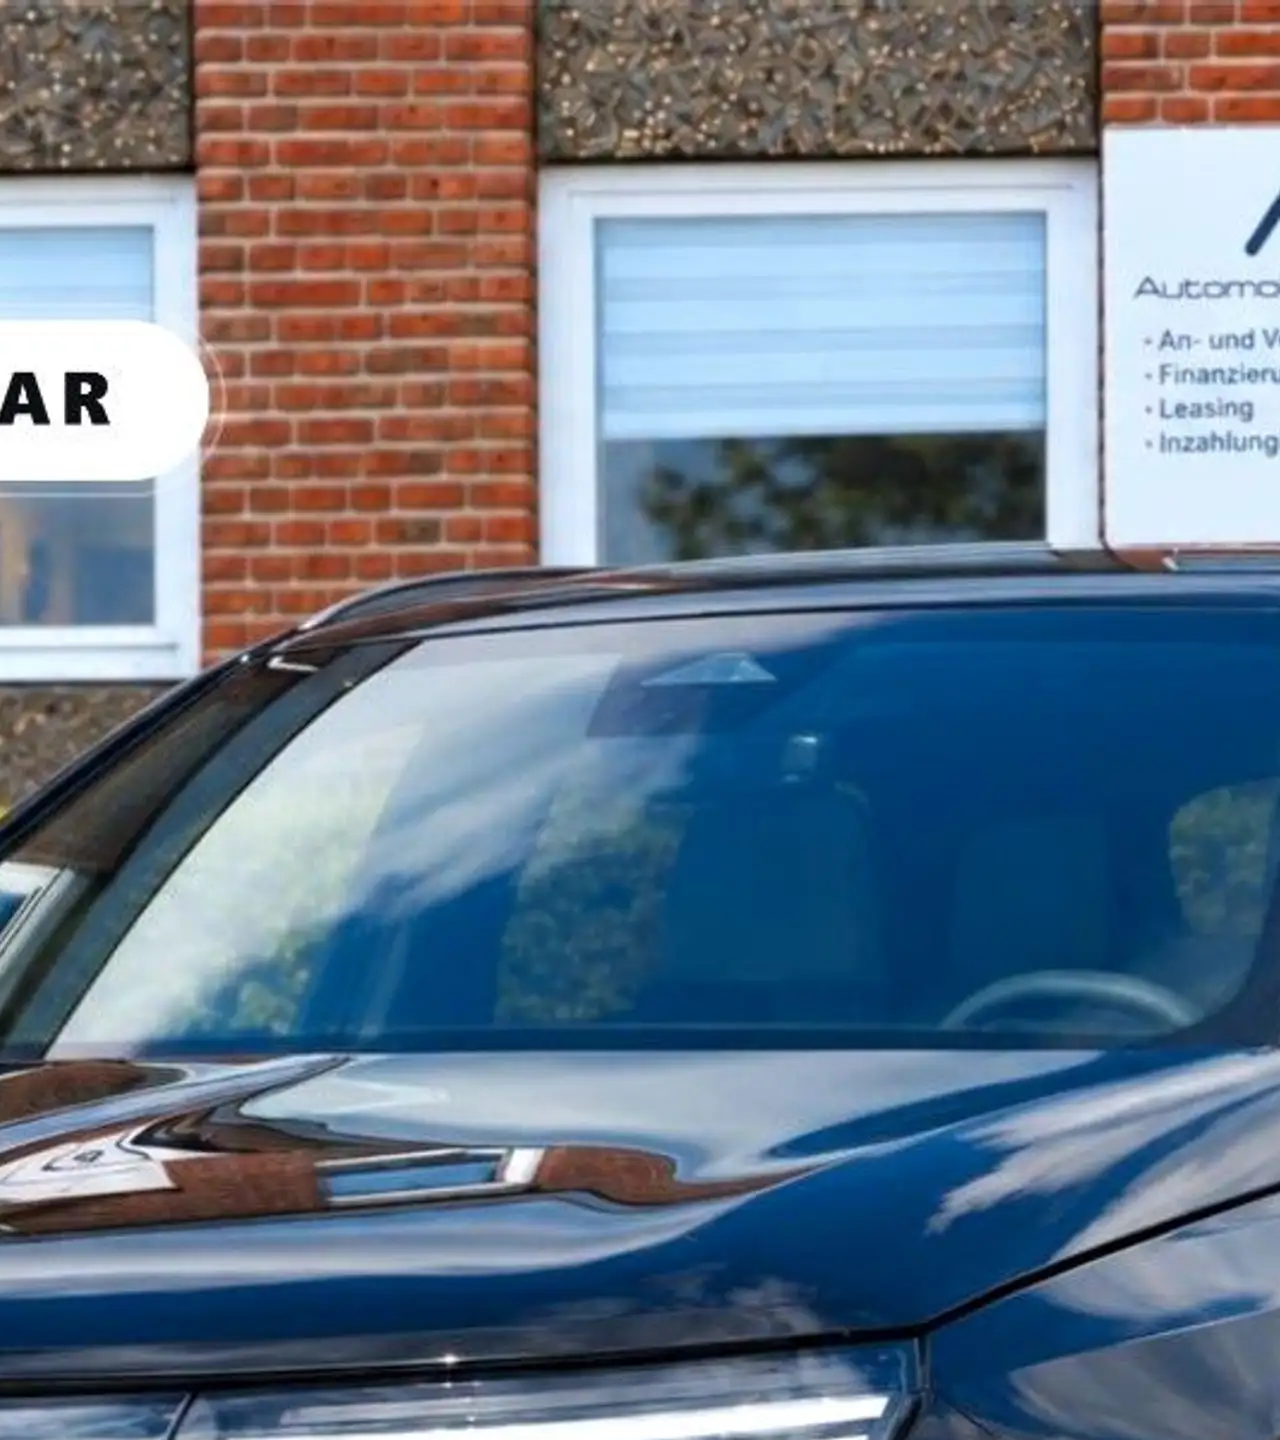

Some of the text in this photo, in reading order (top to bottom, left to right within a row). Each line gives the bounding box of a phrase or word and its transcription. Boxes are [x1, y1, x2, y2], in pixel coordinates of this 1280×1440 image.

[1157, 328, 1202, 351] An-
[1208, 328, 1256, 350] und
[1158, 397, 1255, 423] Leasing
